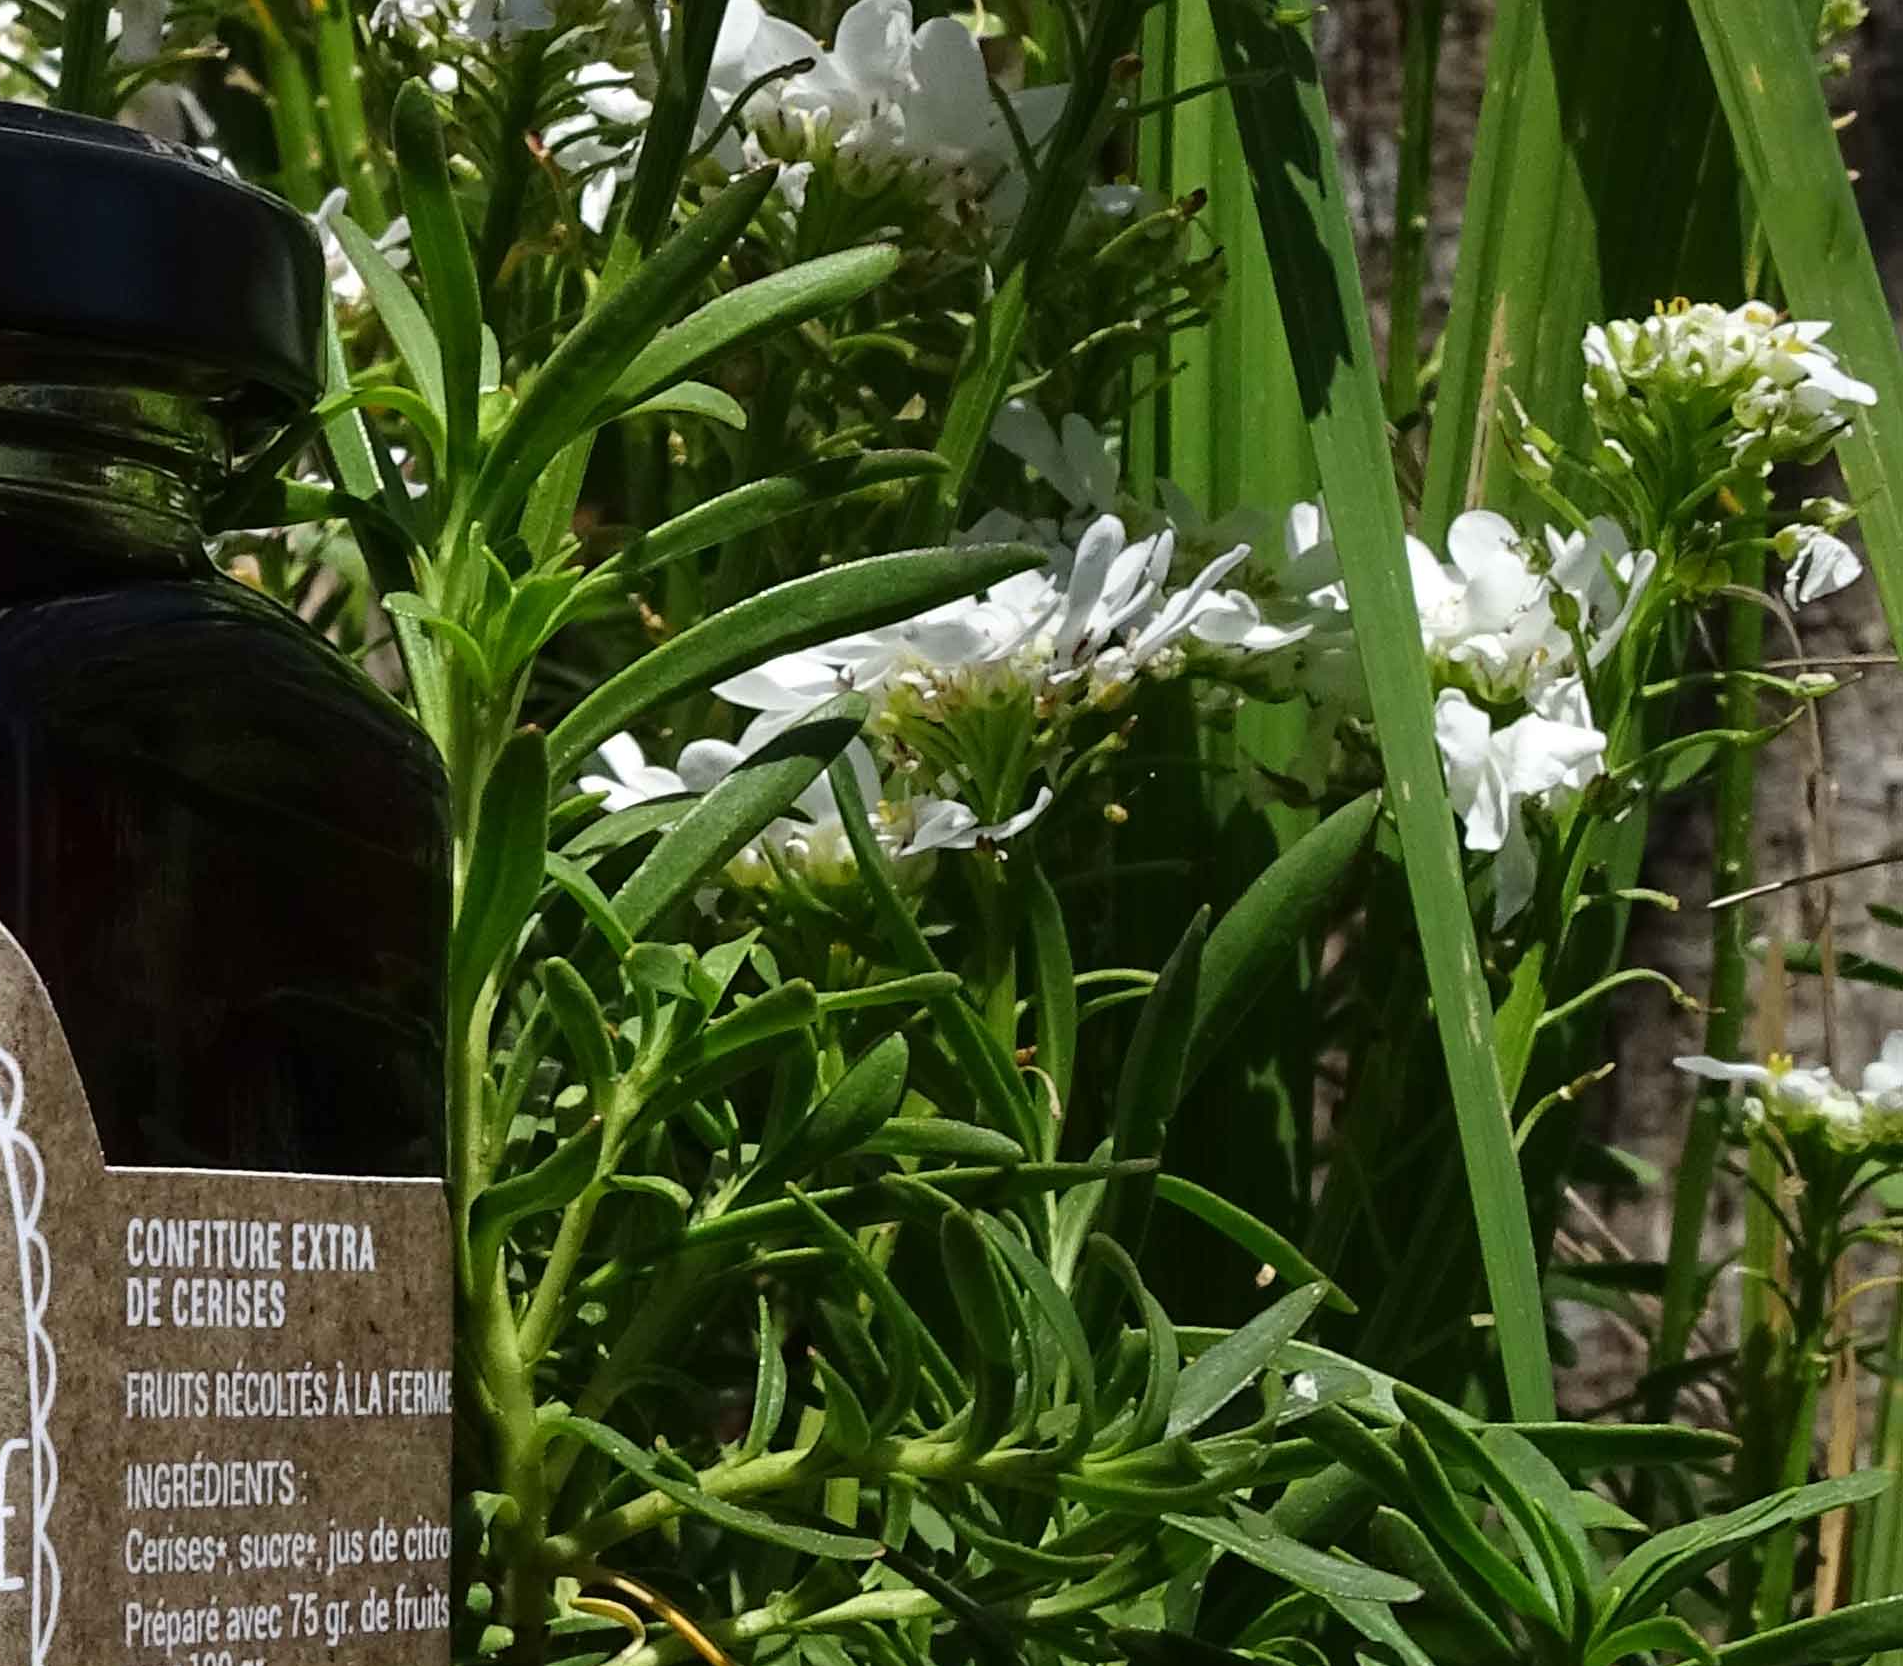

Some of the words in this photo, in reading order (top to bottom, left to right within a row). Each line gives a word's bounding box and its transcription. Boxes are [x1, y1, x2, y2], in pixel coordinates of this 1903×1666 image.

[127, 1217, 282, 1270] CONFITURE
[292, 1223, 375, 1272] EXTRA
[126, 1277, 161, 1327] DE
[172, 1279, 286, 1328] CERISES
[126, 1370, 209, 1418] FRUITS
[215, 1359, 327, 1417] RÉCOLTÉS
[333, 1360, 349, 1415] À
[354, 1371, 382, 1415] LA
[388, 1370, 452, 1415] FERME
[326, 1518, 364, 1575] jus
[369, 1517, 397, 1563] de
[125, 1595, 219, 1658] Préparé
[226, 1603, 282, 1642] avec
[288, 1592, 318, 1637] 75
[325, 1598, 354, 1647] gr.
[360, 1586, 389, 1633] de
[395, 1583, 449, 1631] fruits
